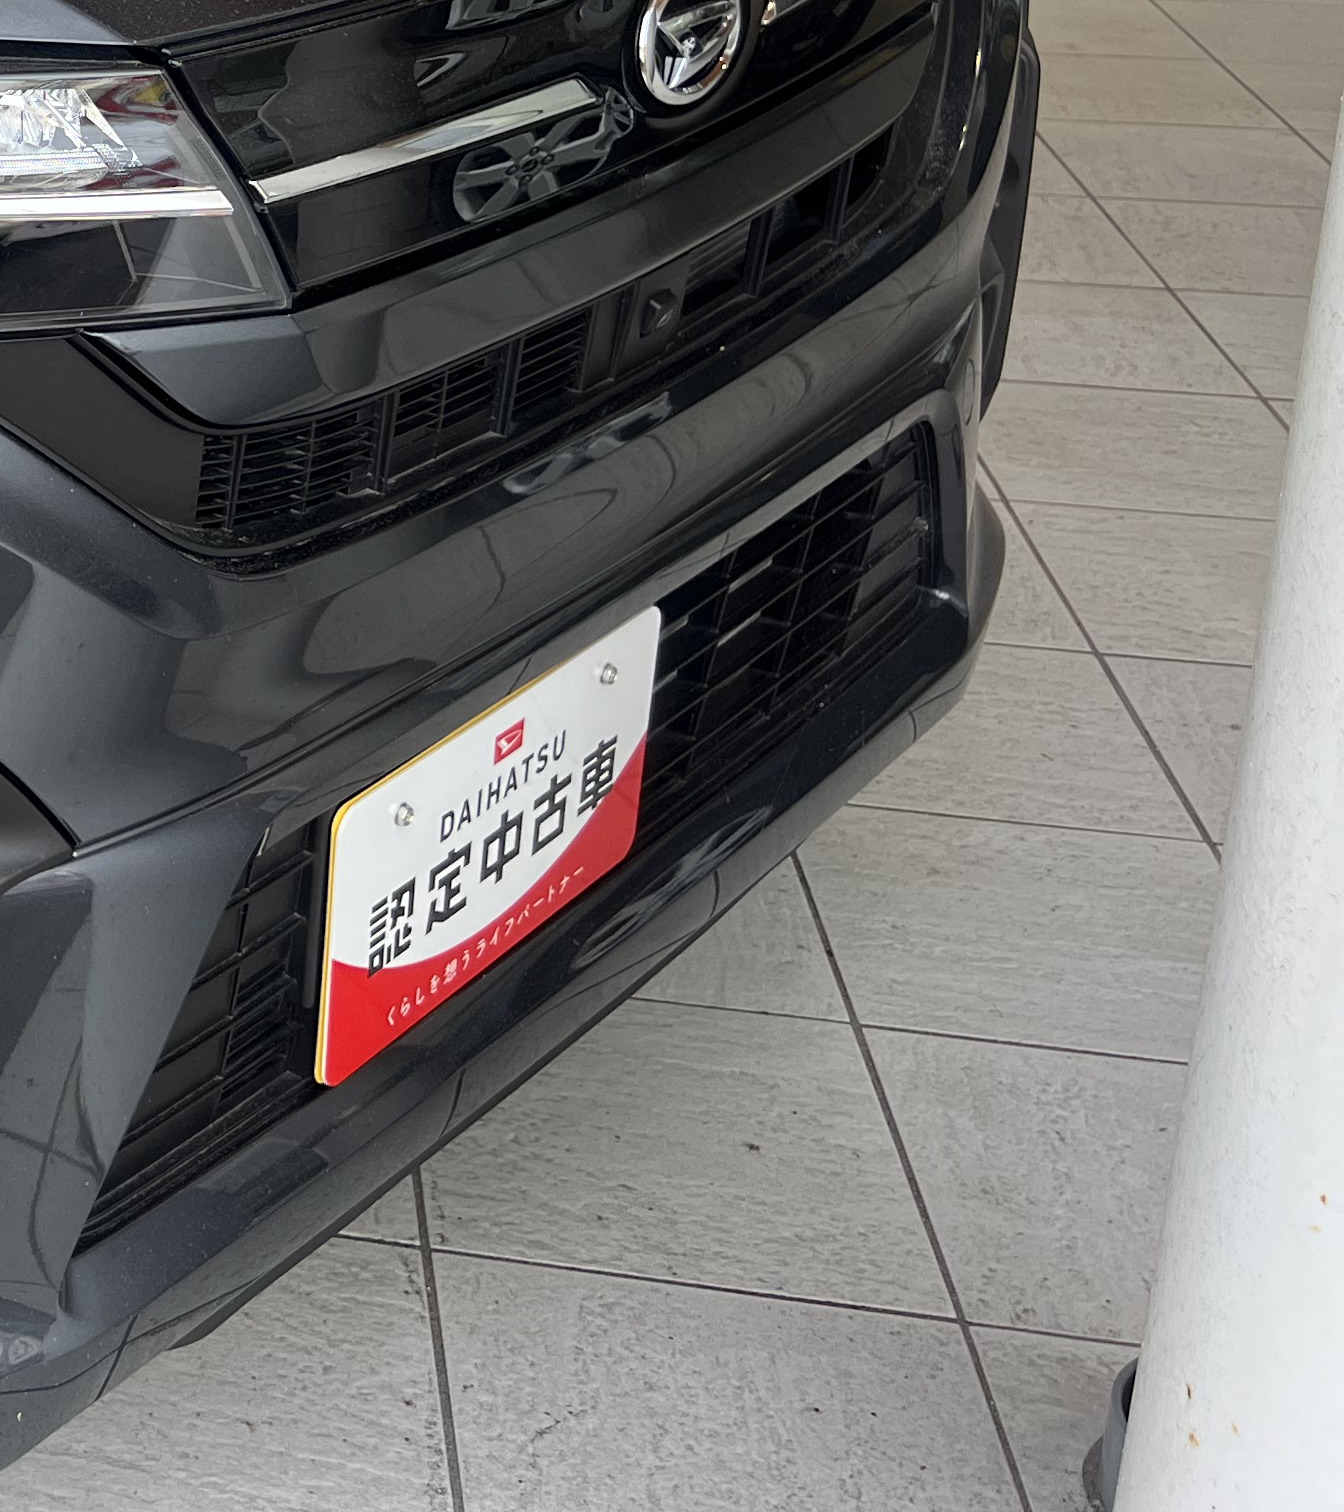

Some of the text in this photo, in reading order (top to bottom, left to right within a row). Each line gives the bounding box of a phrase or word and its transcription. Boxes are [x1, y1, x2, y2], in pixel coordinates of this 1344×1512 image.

[366, 735, 619, 979] 認定中古車
[439, 729, 568, 843] DAIHATSU
[386, 866, 585, 1027] くらしを想うライフパートナー
